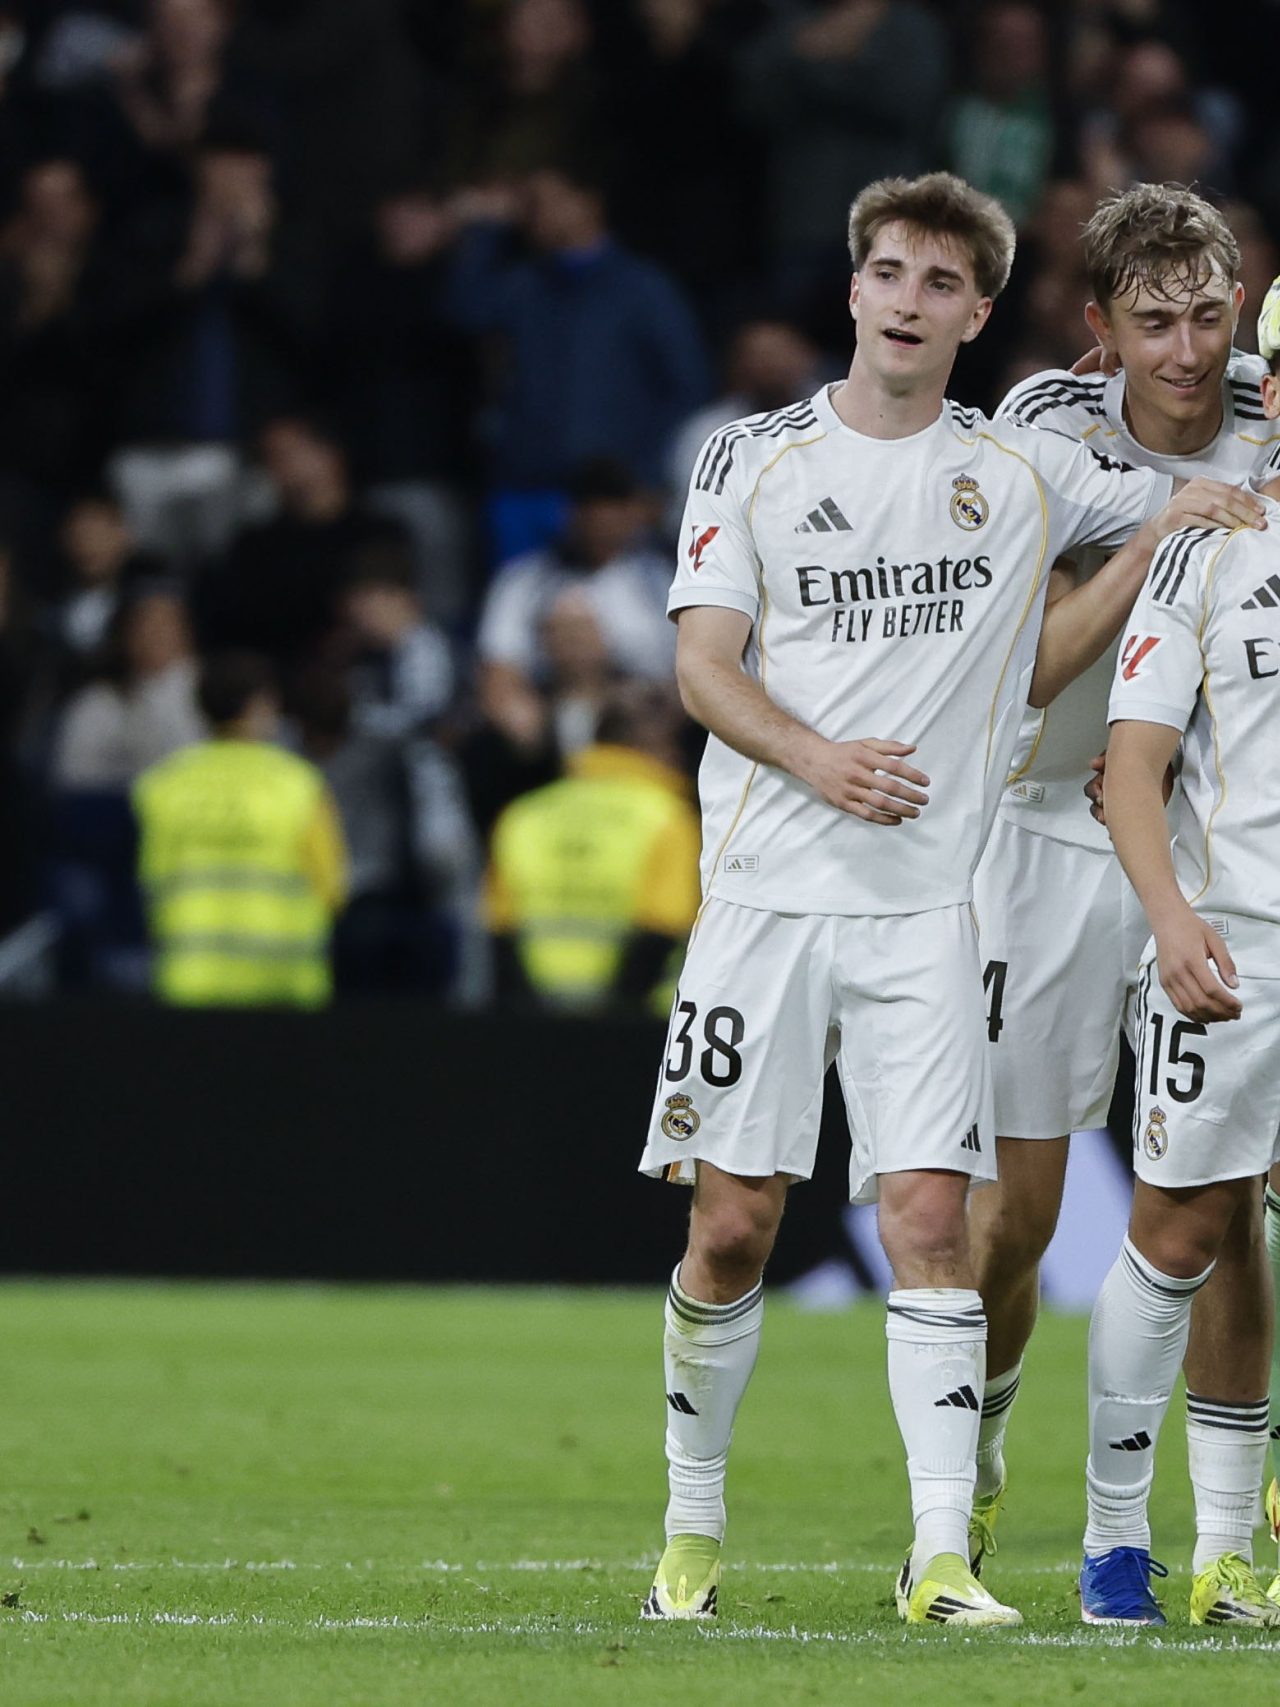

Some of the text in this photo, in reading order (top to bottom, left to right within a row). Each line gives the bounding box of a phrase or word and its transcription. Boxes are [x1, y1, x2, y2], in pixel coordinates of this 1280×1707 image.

[795, 554, 993, 607] Emirates
[831, 599, 964, 643] FLY BETTER
[665, 1000, 745, 1088] 38
[1149, 1012, 1209, 1104] 15
